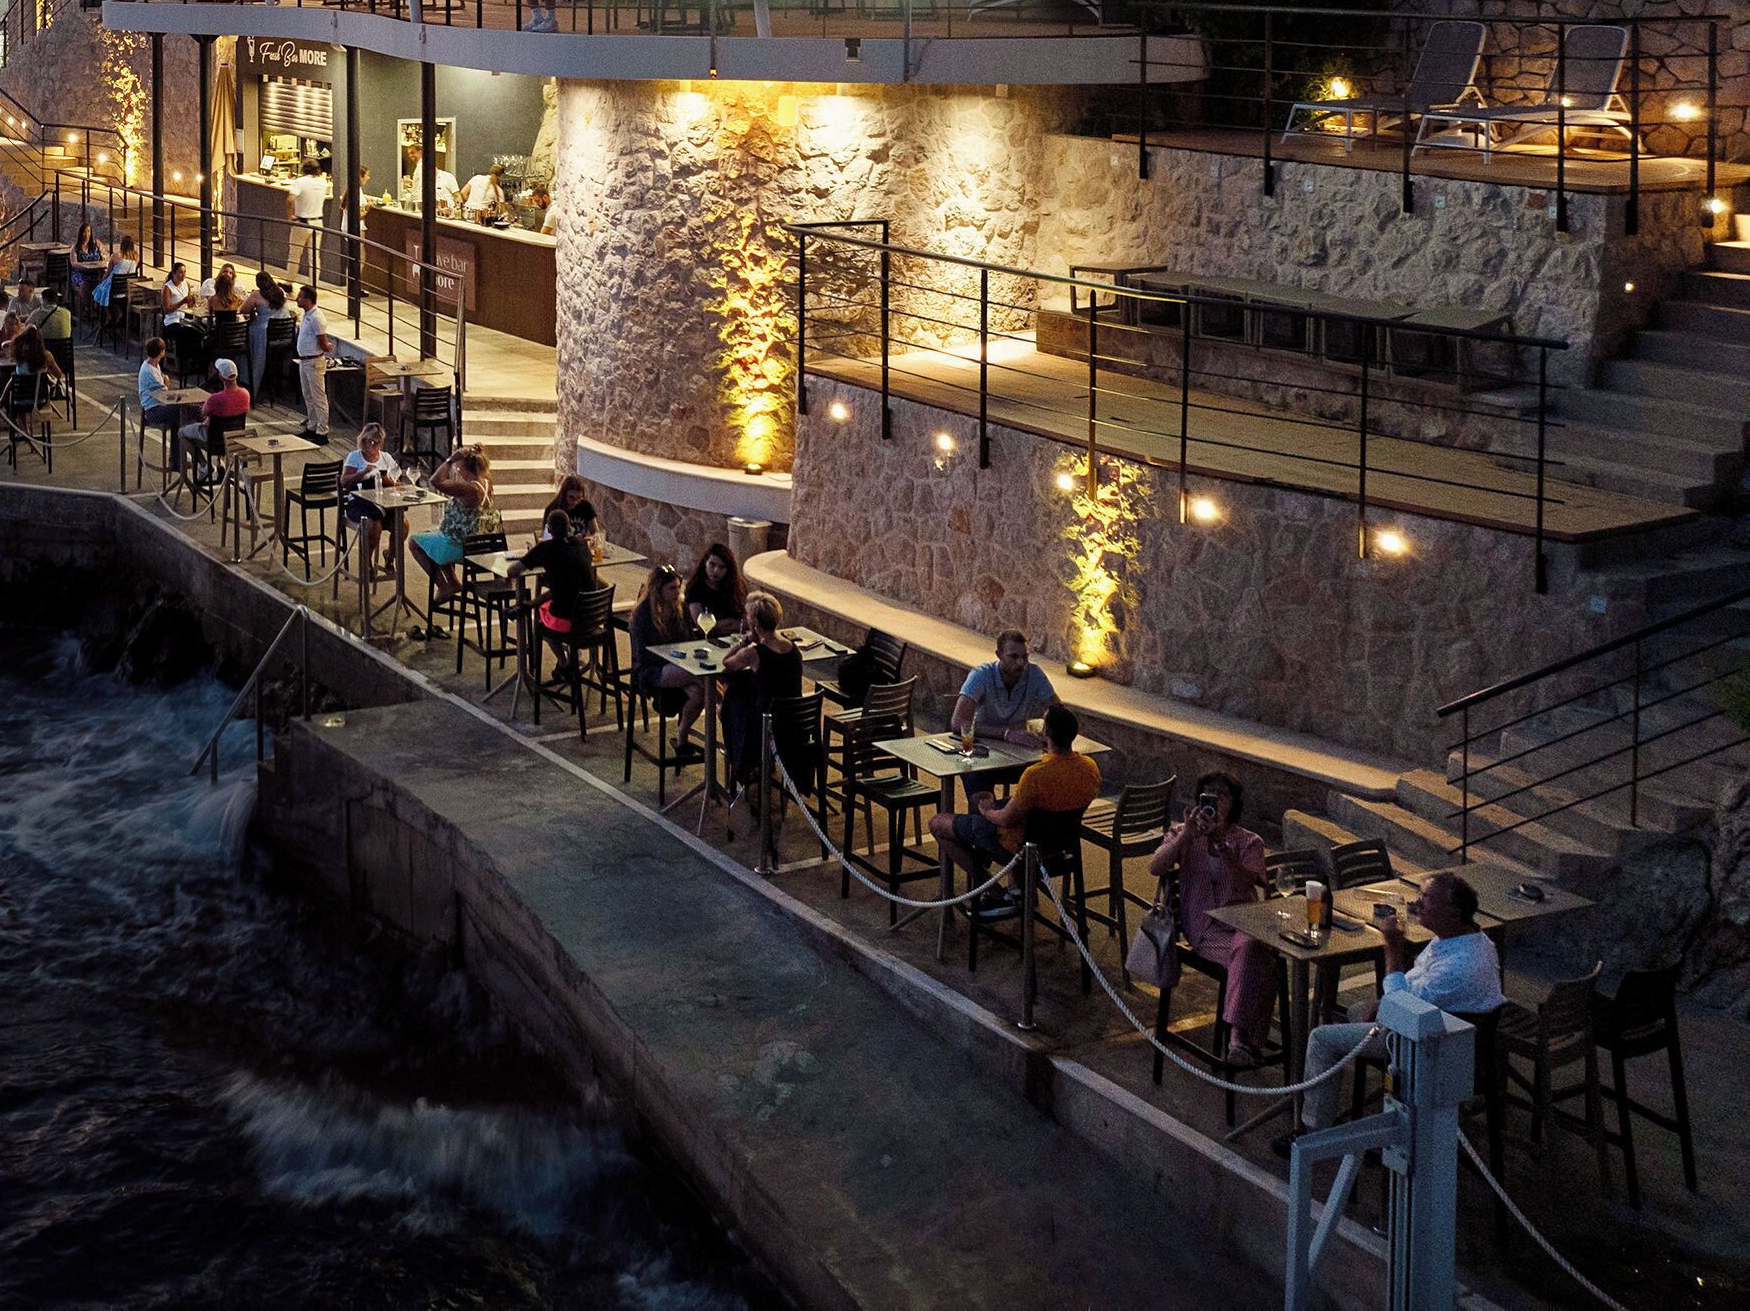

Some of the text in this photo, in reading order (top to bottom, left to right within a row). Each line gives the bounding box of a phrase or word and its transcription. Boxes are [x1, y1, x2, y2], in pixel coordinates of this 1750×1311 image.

[299, 49, 327, 66] MORE
[451, 254, 467, 272] bar
[435, 275, 455, 290] ore
